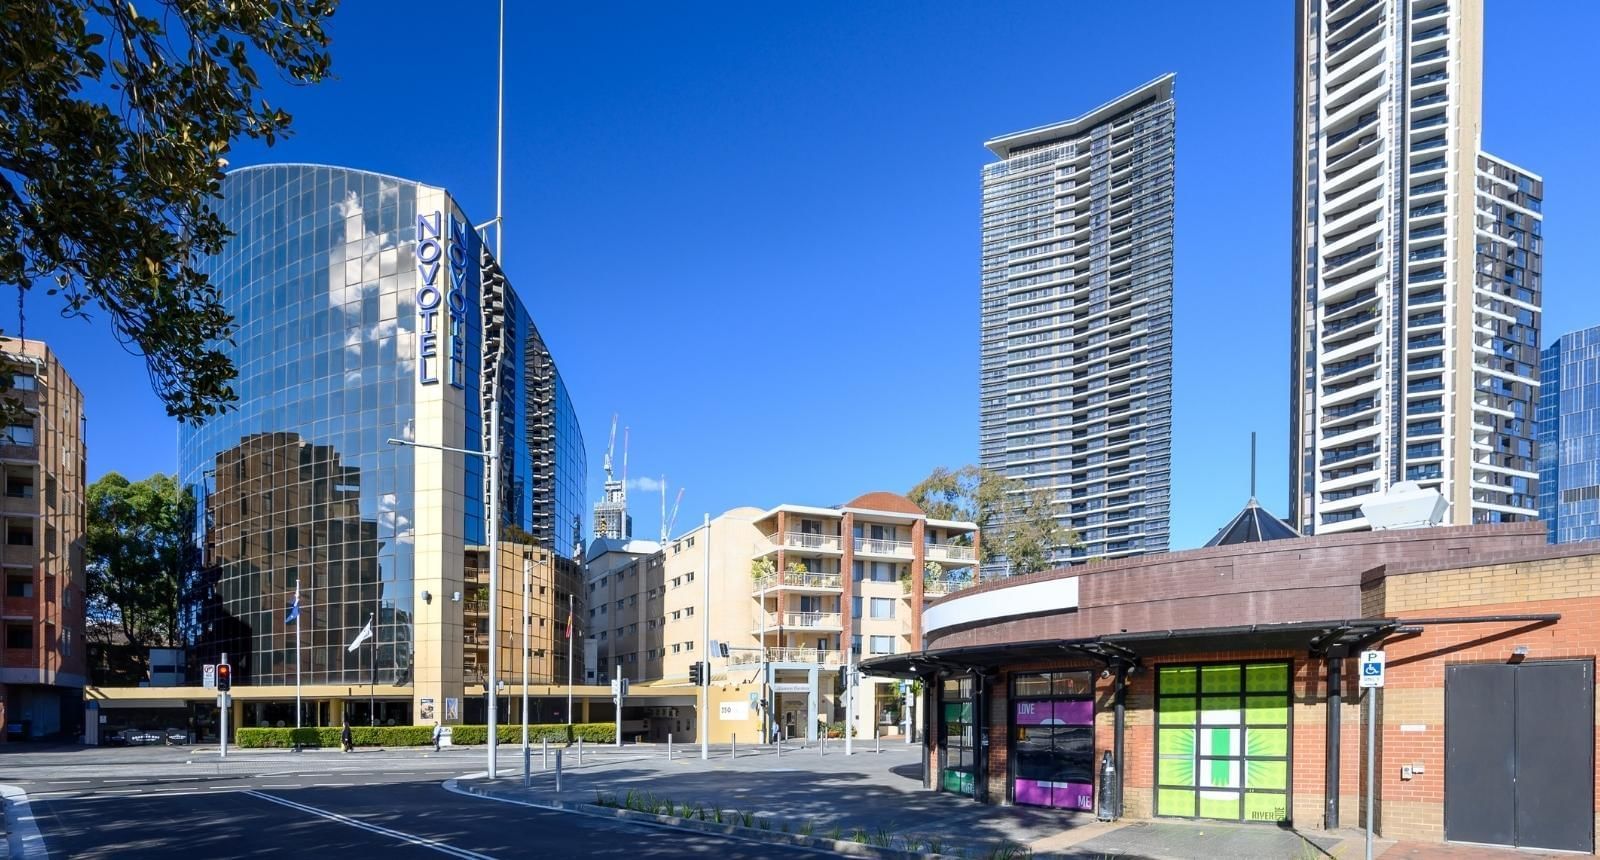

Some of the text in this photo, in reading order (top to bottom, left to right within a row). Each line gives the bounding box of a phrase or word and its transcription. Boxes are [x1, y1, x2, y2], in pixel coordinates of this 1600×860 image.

[416, 211, 441, 384] NOVOTEL
[447, 212, 467, 389] NOVOTEL
[1368, 653, 1377, 661] P
[1018, 703, 1035, 715] LOVE
[1078, 795, 1092, 810] ME
[1251, 811, 1274, 819] RIVER
